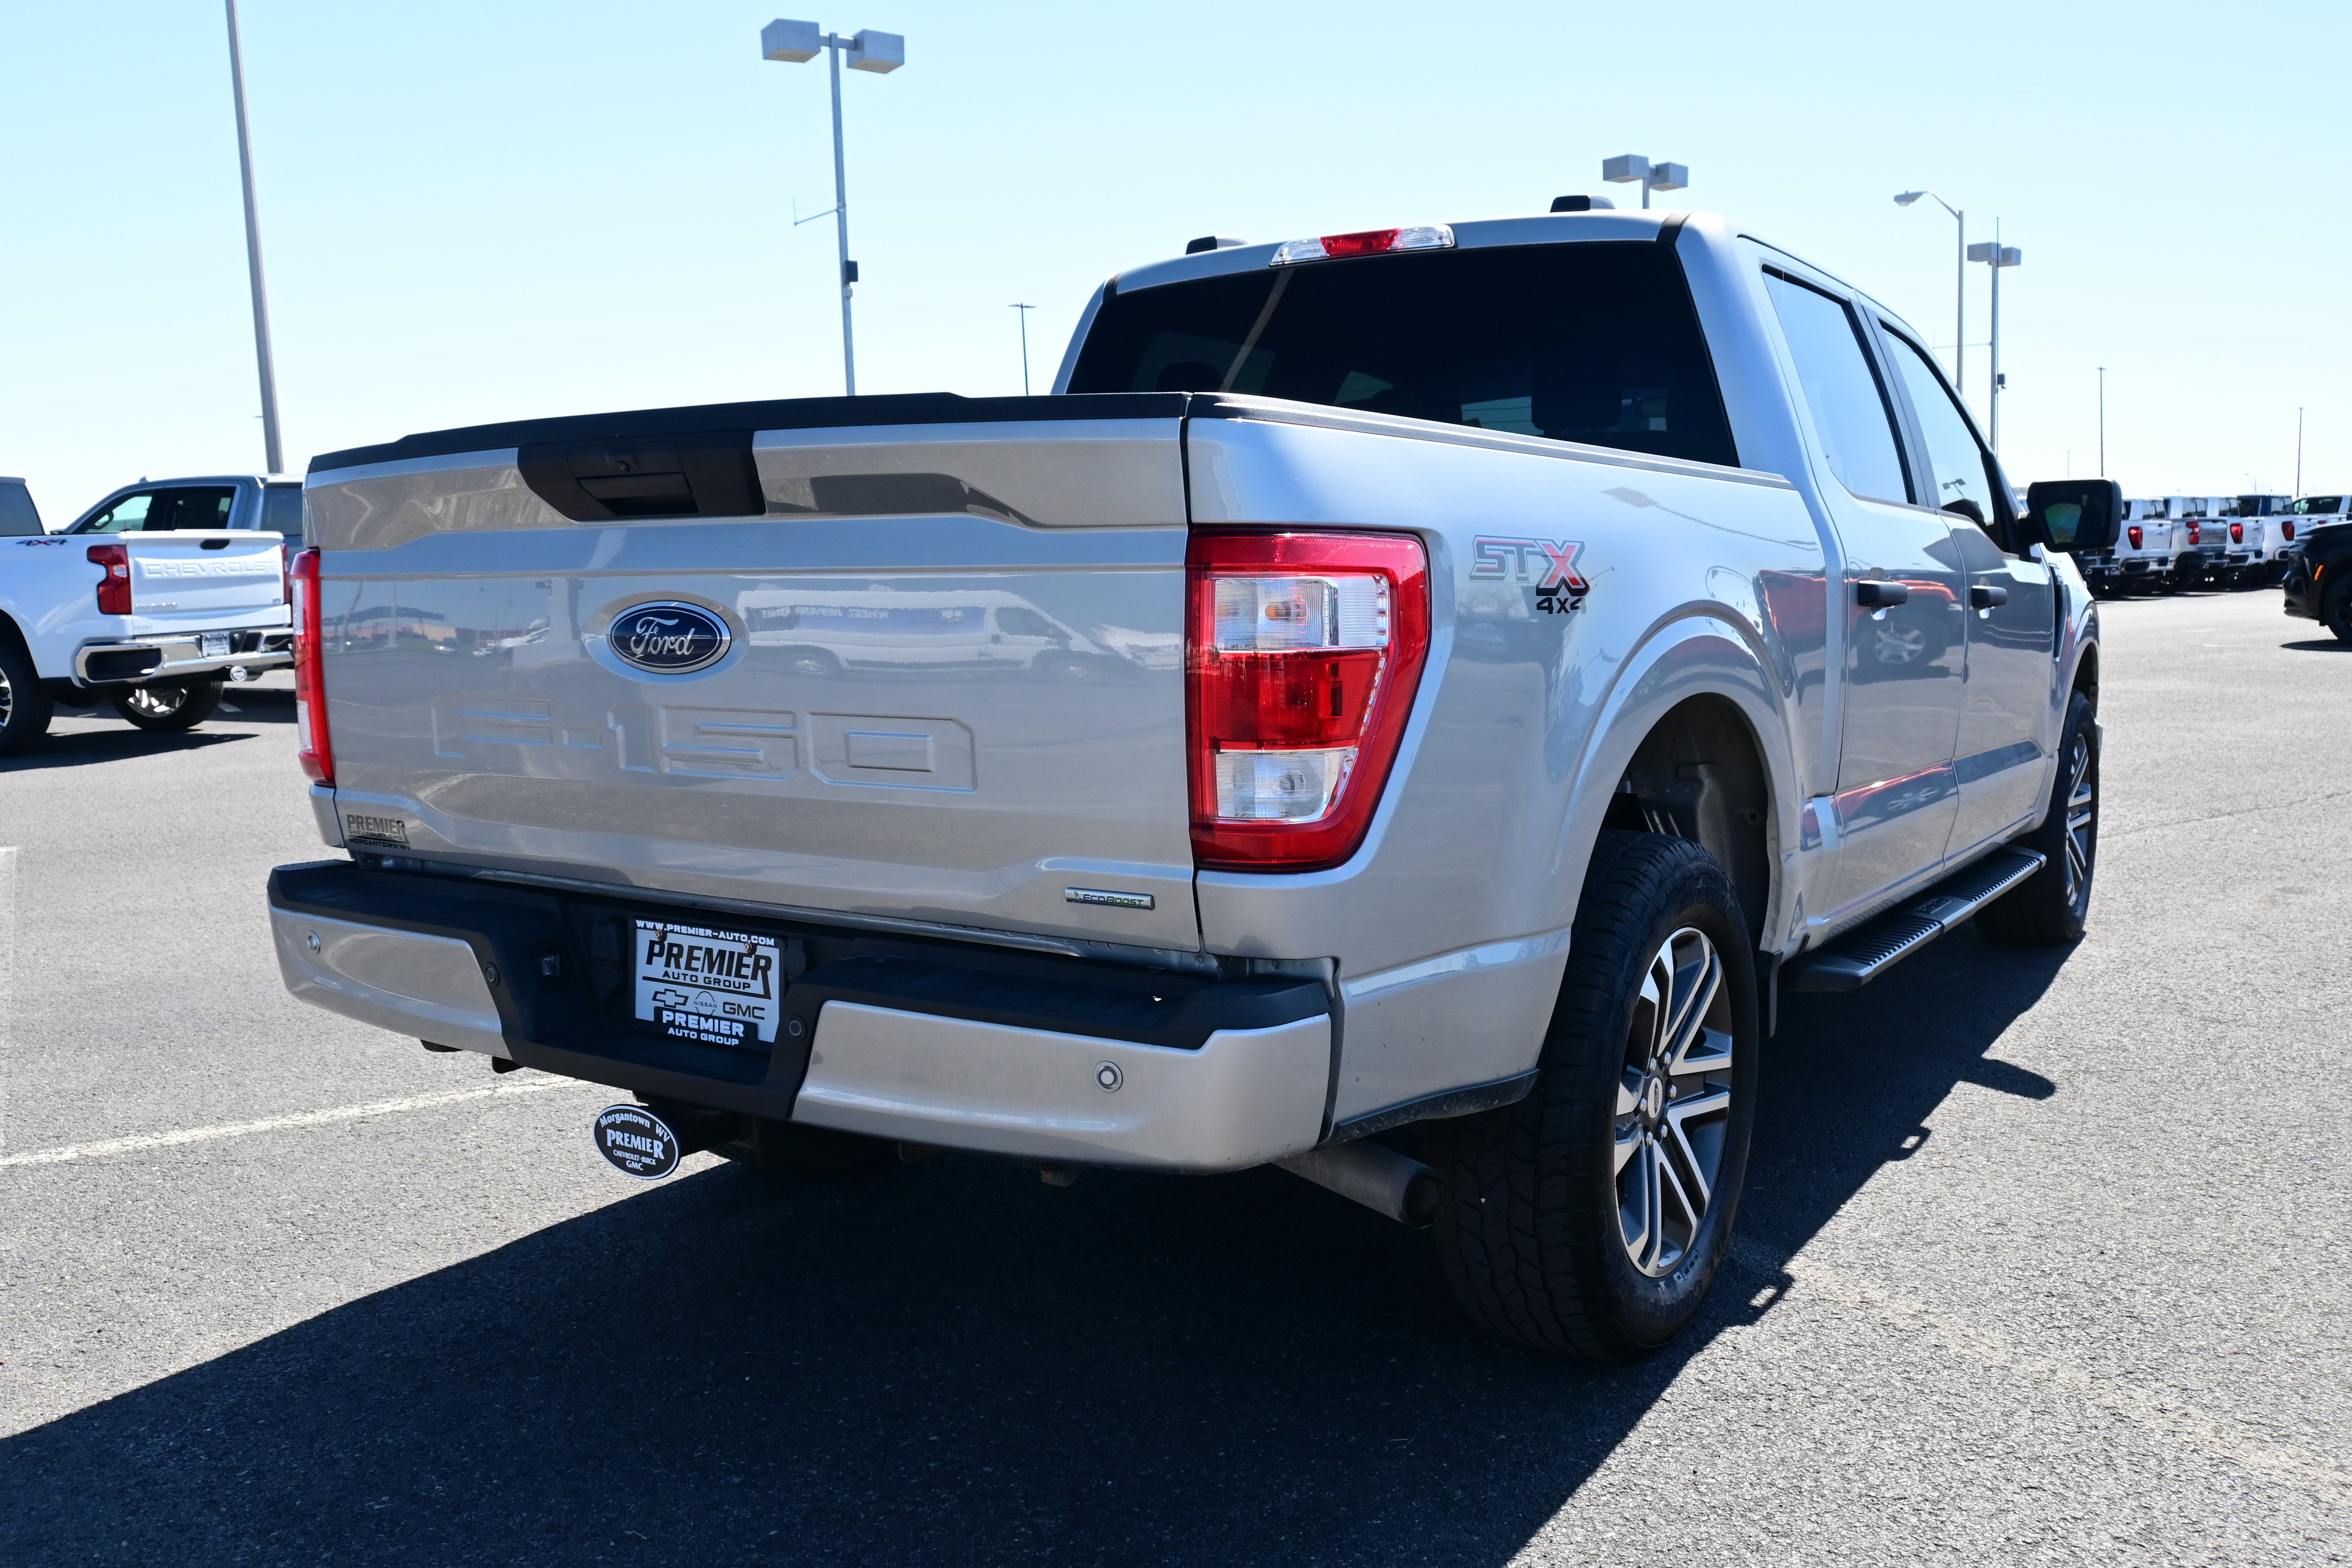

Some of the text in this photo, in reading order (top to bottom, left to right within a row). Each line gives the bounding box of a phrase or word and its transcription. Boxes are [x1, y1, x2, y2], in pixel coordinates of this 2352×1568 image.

[145, 561, 276, 577] CHEVROLET
[1469, 535, 1590, 596] STX
[630, 616, 695, 655] Ford
[431, 696, 977, 794] F-150
[347, 814, 409, 844] PREMIER
[348, 830, 386, 838] CHEVROLET
[349, 838, 398, 849] MORGANTOWN
[636, 920, 774, 946] WWW.PREMIER-AUTO.COM
[646, 939, 772, 999] PREMIER
[662, 970, 751, 990] AUTO GROUP
[694, 1001, 717, 1009] NISSAN
[723, 1002, 765, 1020] GMC
[662, 1010, 744, 1037] PREMIER
[668, 1027, 739, 1046] AUTO GROUP
[599, 1112, 670, 1143] Morgantown WV
[606, 1128, 665, 1160] PREMIER
[613, 1149, 656, 1166] CHEVROLET BUICK
[626, 1160, 644, 1171] GMC
